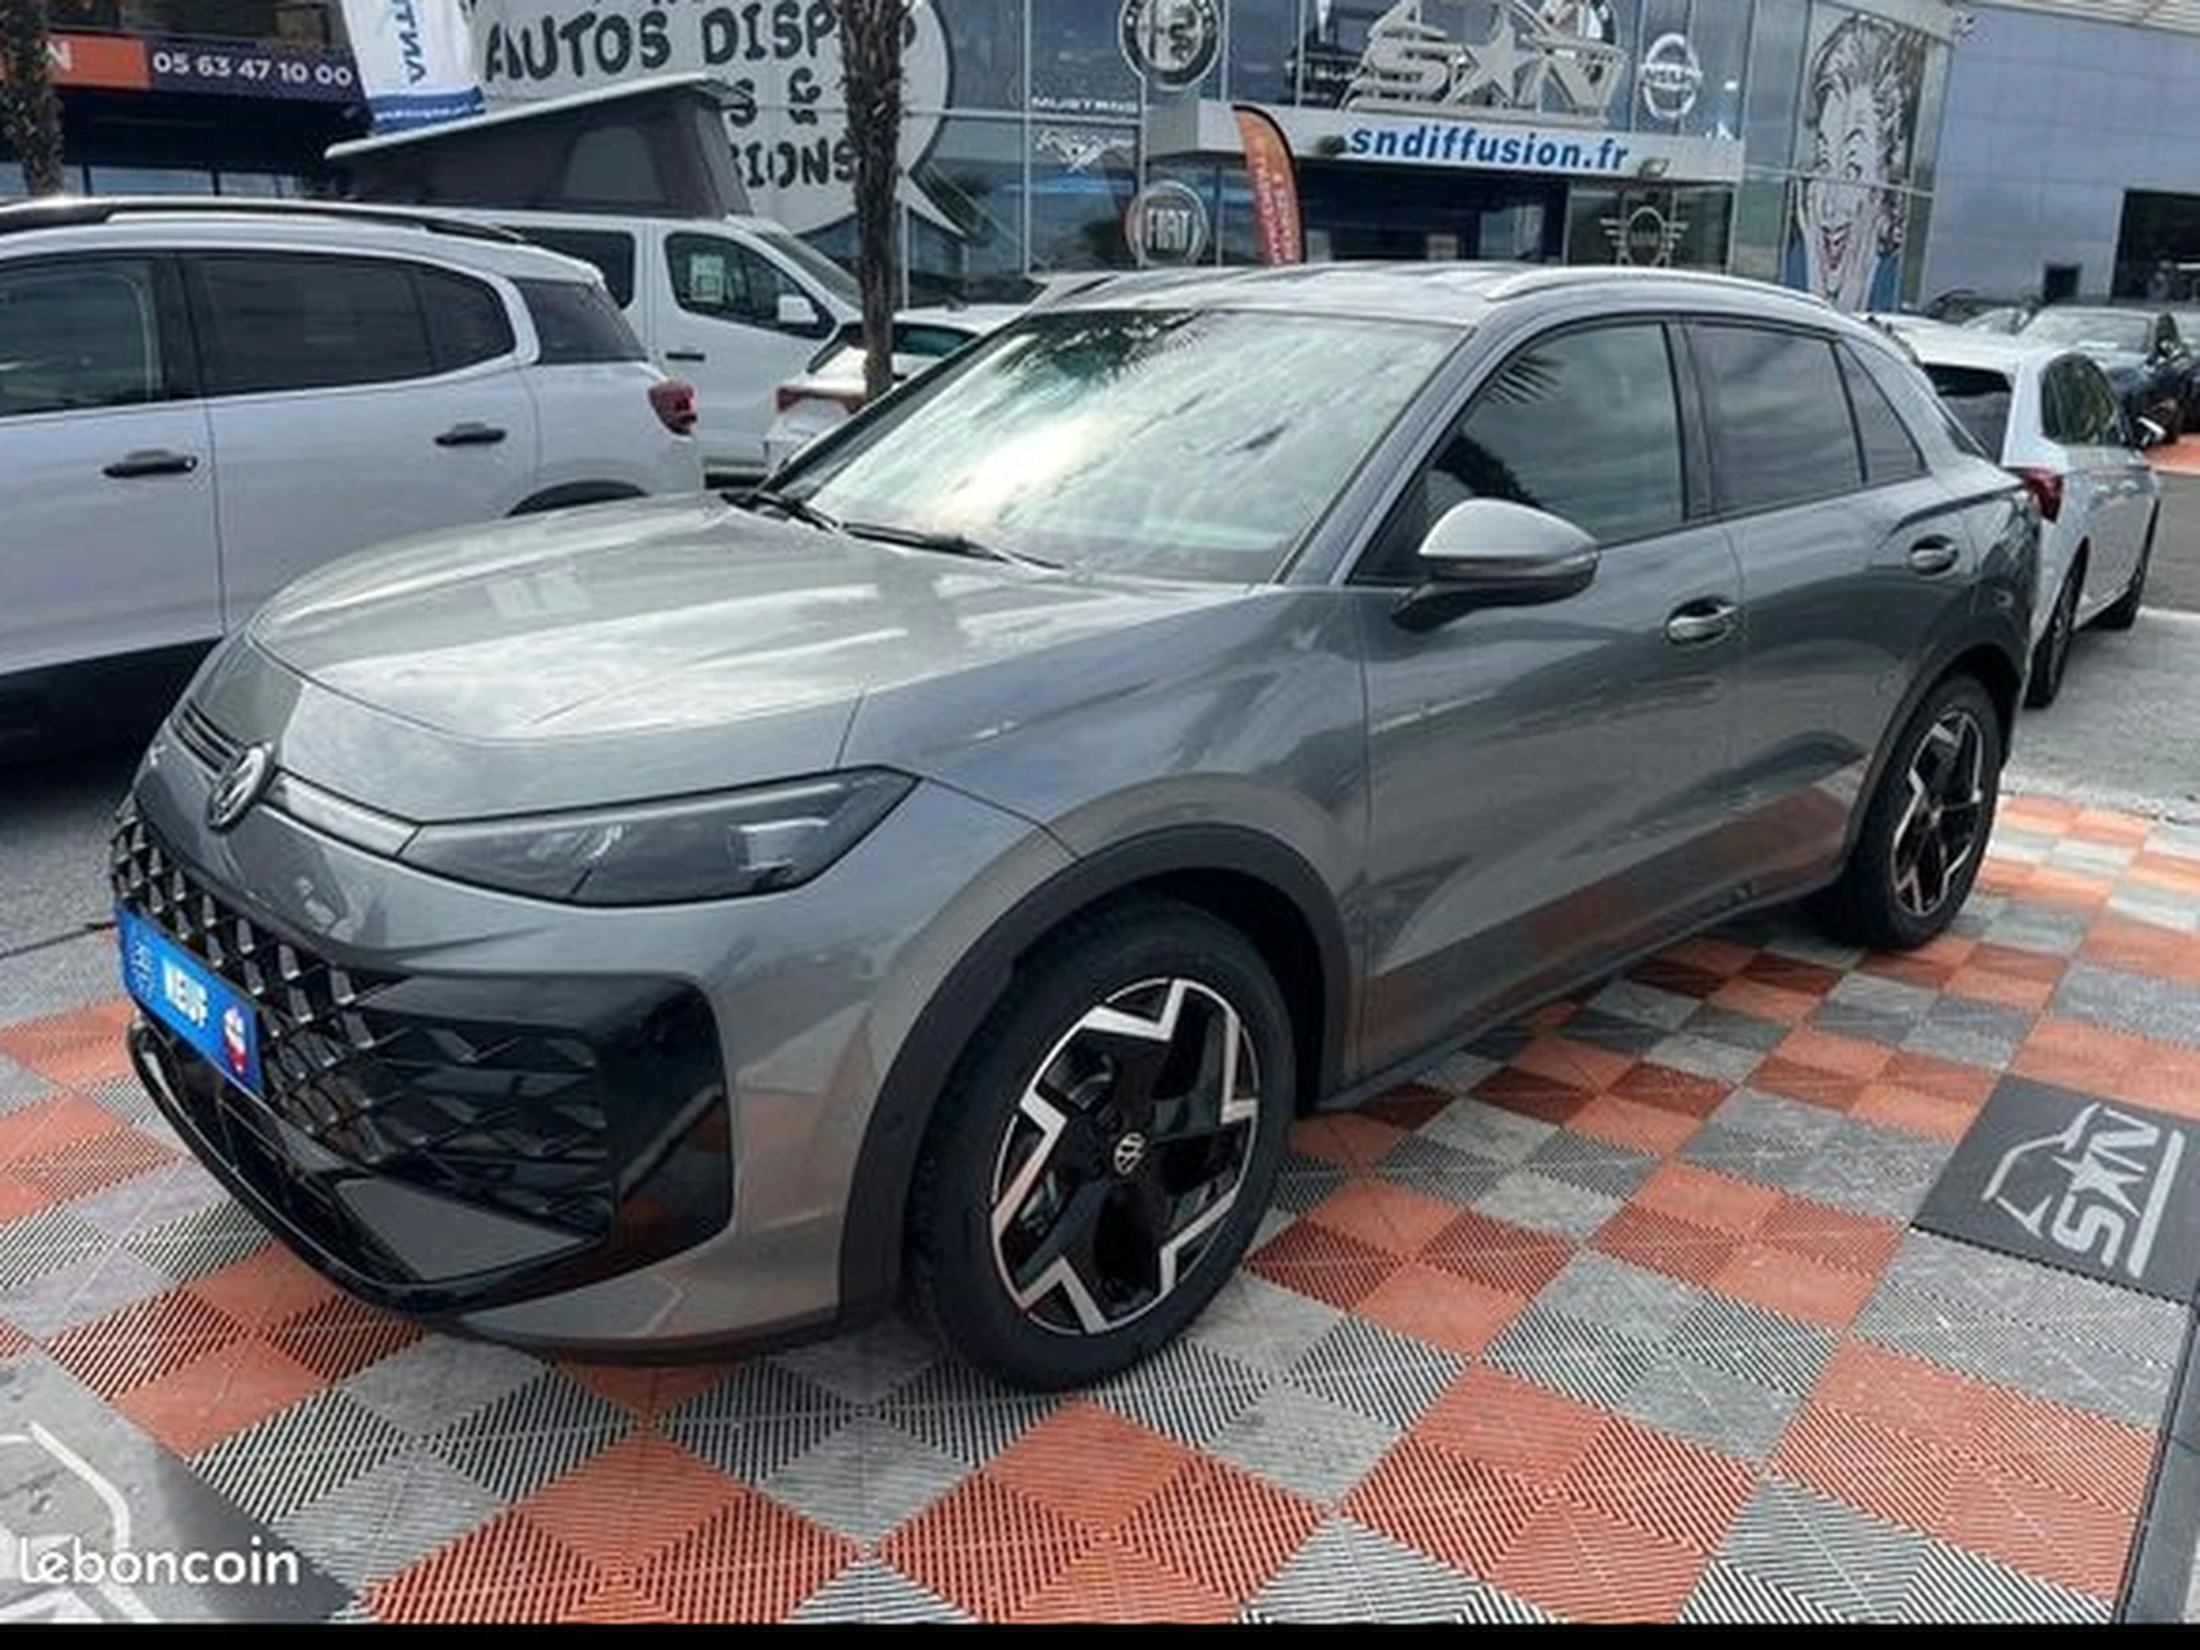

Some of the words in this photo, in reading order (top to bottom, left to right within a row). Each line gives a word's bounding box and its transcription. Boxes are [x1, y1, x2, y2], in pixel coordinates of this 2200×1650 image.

[153, 51, 190, 75] 05
[198, 55, 231, 77] 63
[238, 59, 271, 80] 47
[279, 62, 308, 83] 10
[315, 64, 351, 87] 00
[485, 10, 671, 82] AUTOS
[1351, 124, 1628, 171] sndiffusion.fr
